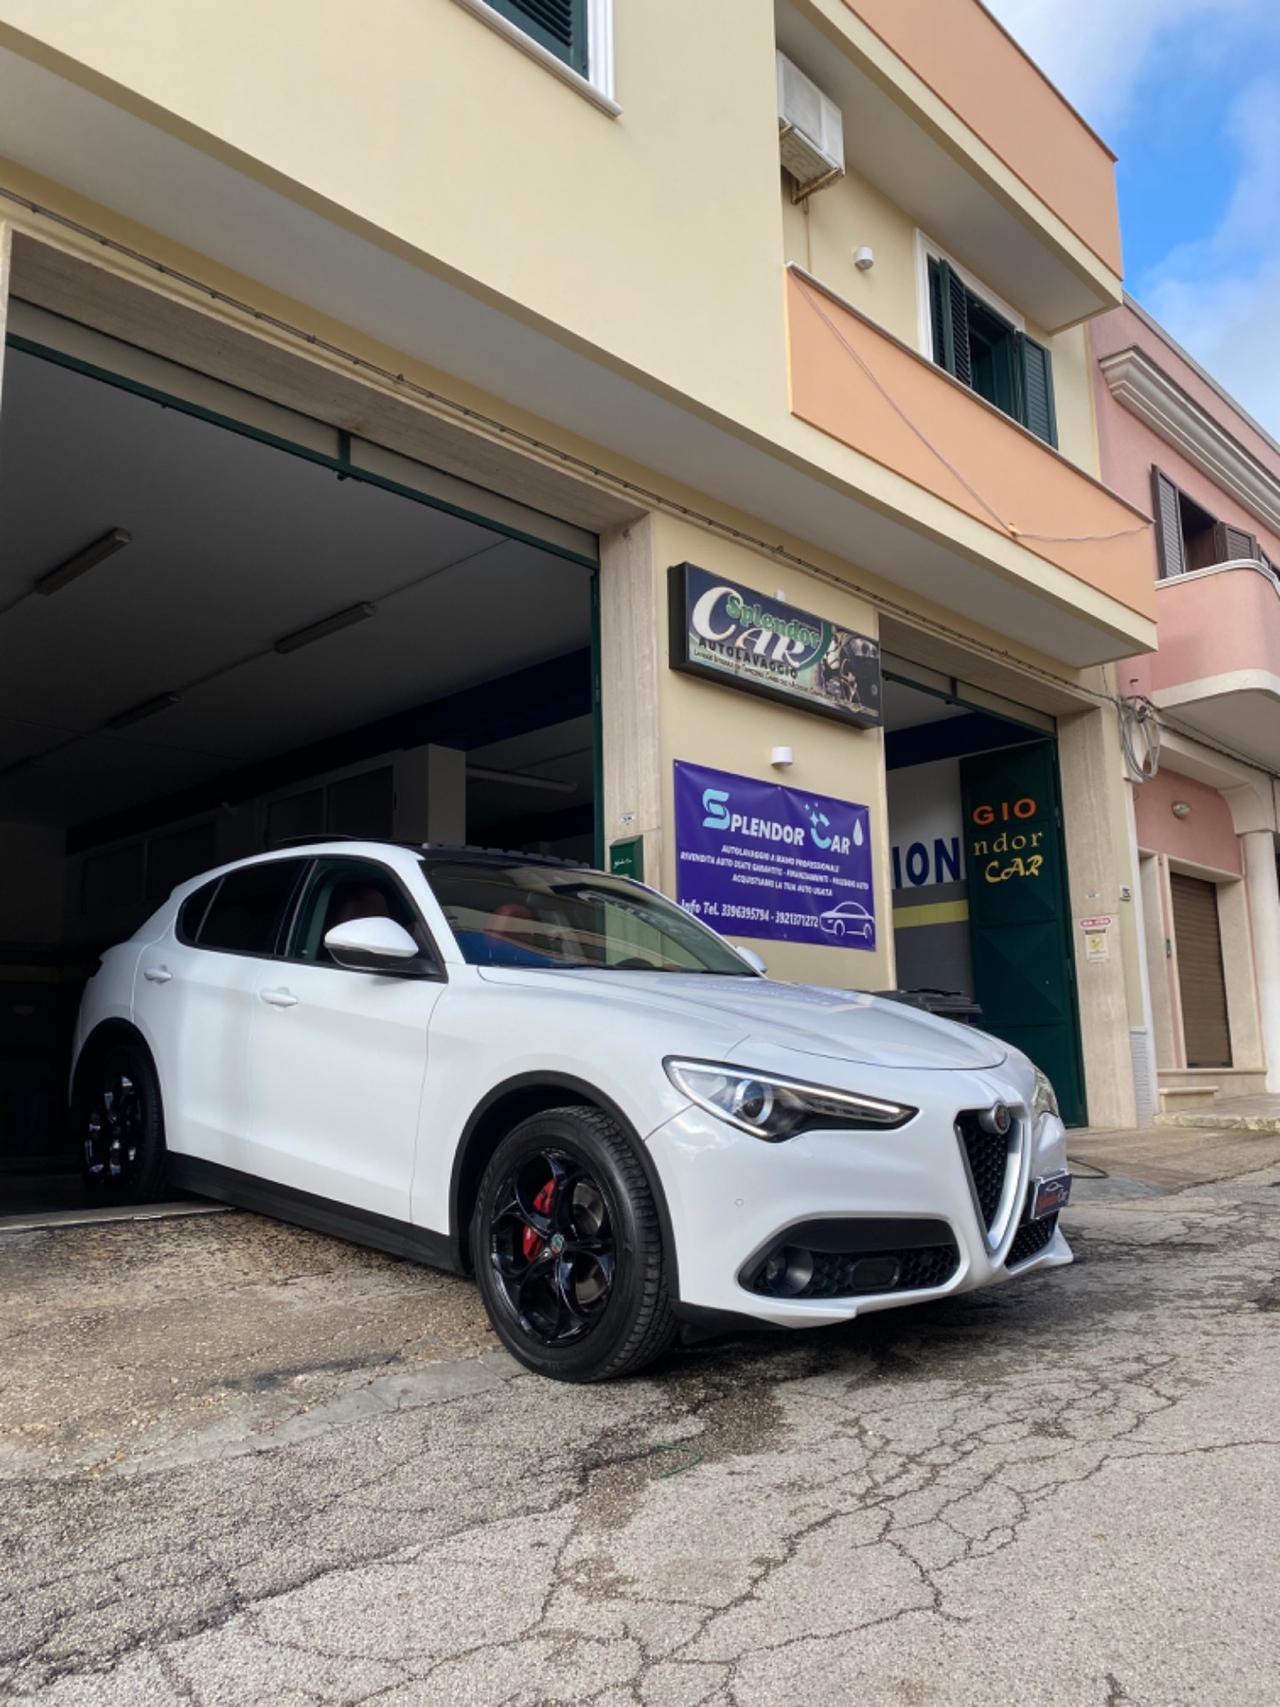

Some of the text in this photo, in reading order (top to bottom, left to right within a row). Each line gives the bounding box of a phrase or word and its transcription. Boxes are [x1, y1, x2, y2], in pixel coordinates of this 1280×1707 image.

[692, 586, 806, 668] CAR
[726, 594, 821, 649] Splendor
[698, 638, 798, 680] AUTOLAVAGGIO
[702, 788, 851, 856] SPLENDOR CAR
[972, 798, 1038, 826] GIO
[973, 831, 1044, 857] ndor
[985, 854, 1045, 884] CAR
